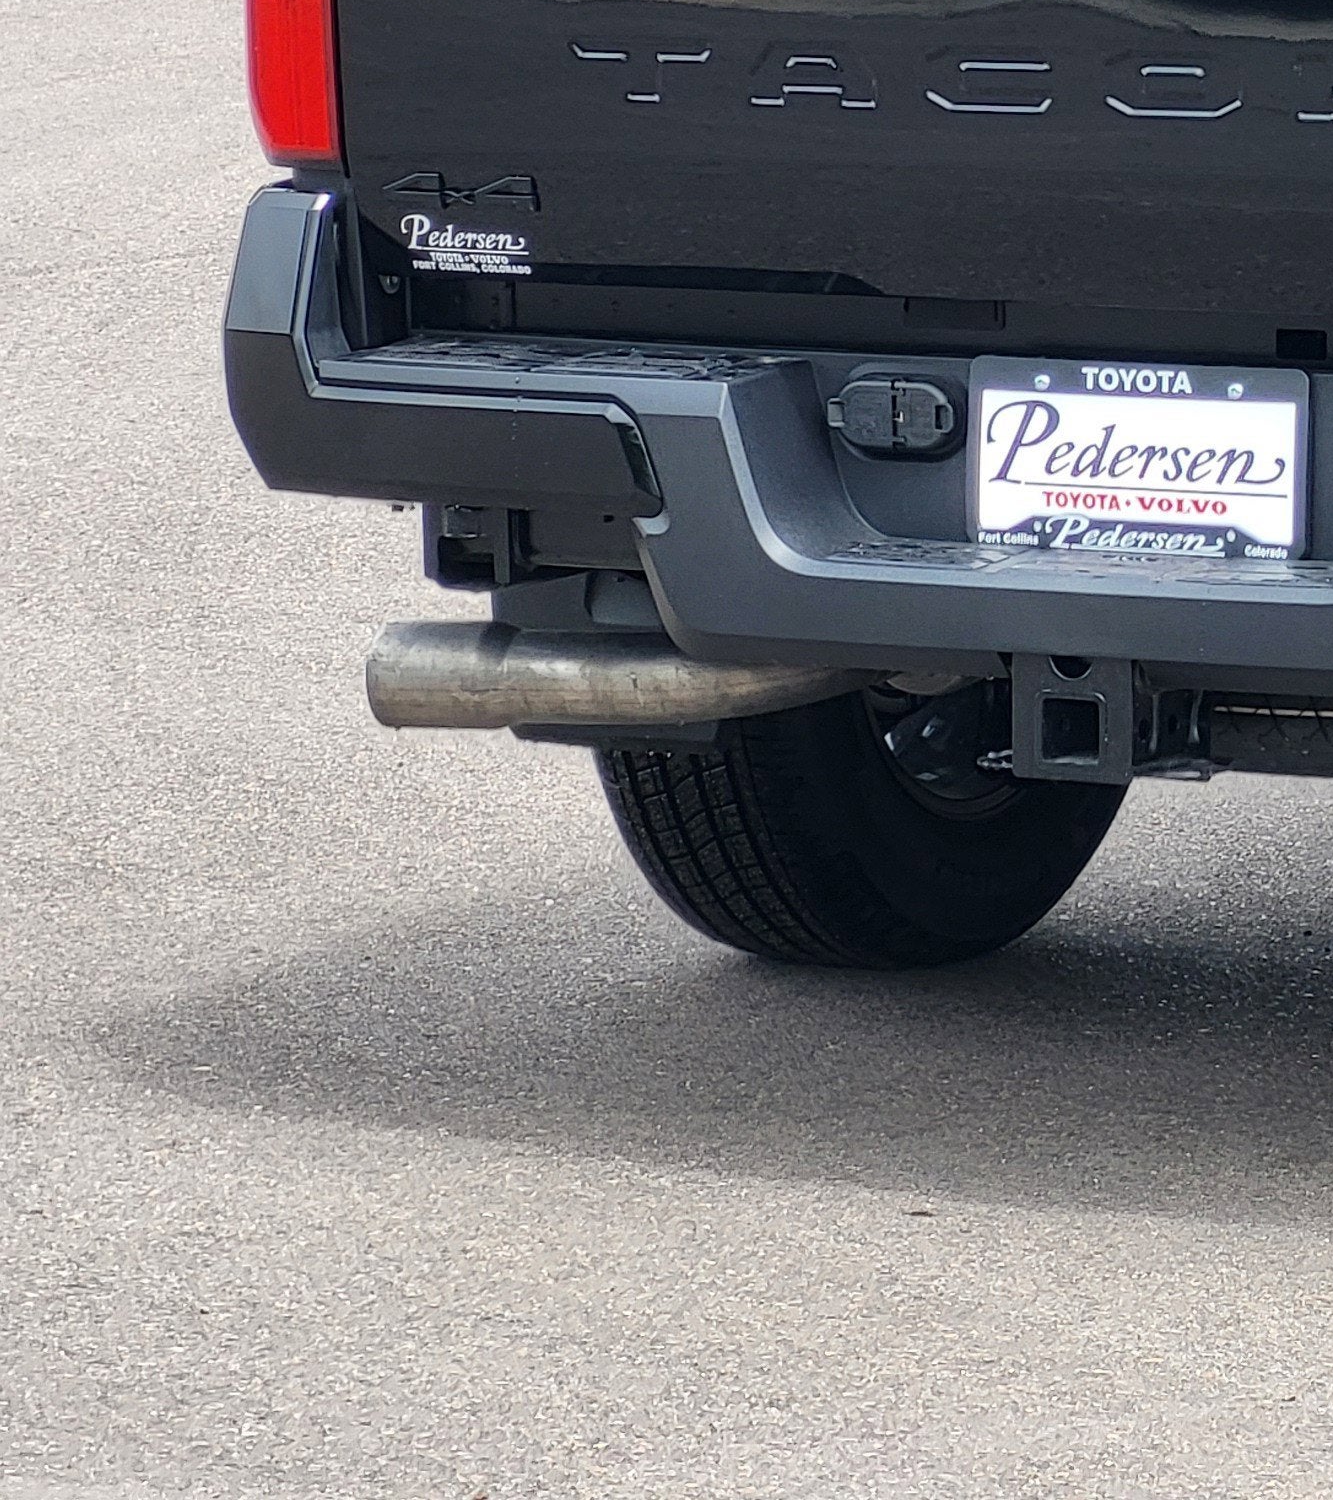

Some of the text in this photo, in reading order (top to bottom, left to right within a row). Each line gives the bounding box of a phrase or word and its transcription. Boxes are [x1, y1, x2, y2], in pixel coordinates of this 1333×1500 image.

[400, 213, 530, 255] Pedersen
[430, 252, 509, 265] TOYOTA VOLVO
[1081, 366, 1193, 395] TOYOTA
[987, 400, 1287, 485] Pedersen
[1043, 491, 1228, 516] TOYOTA VOLVO
[977, 531, 1040, 546] Fort Collins
[1044, 513, 1226, 558] Pedersen
[1243, 544, 1289, 560] Colorado
